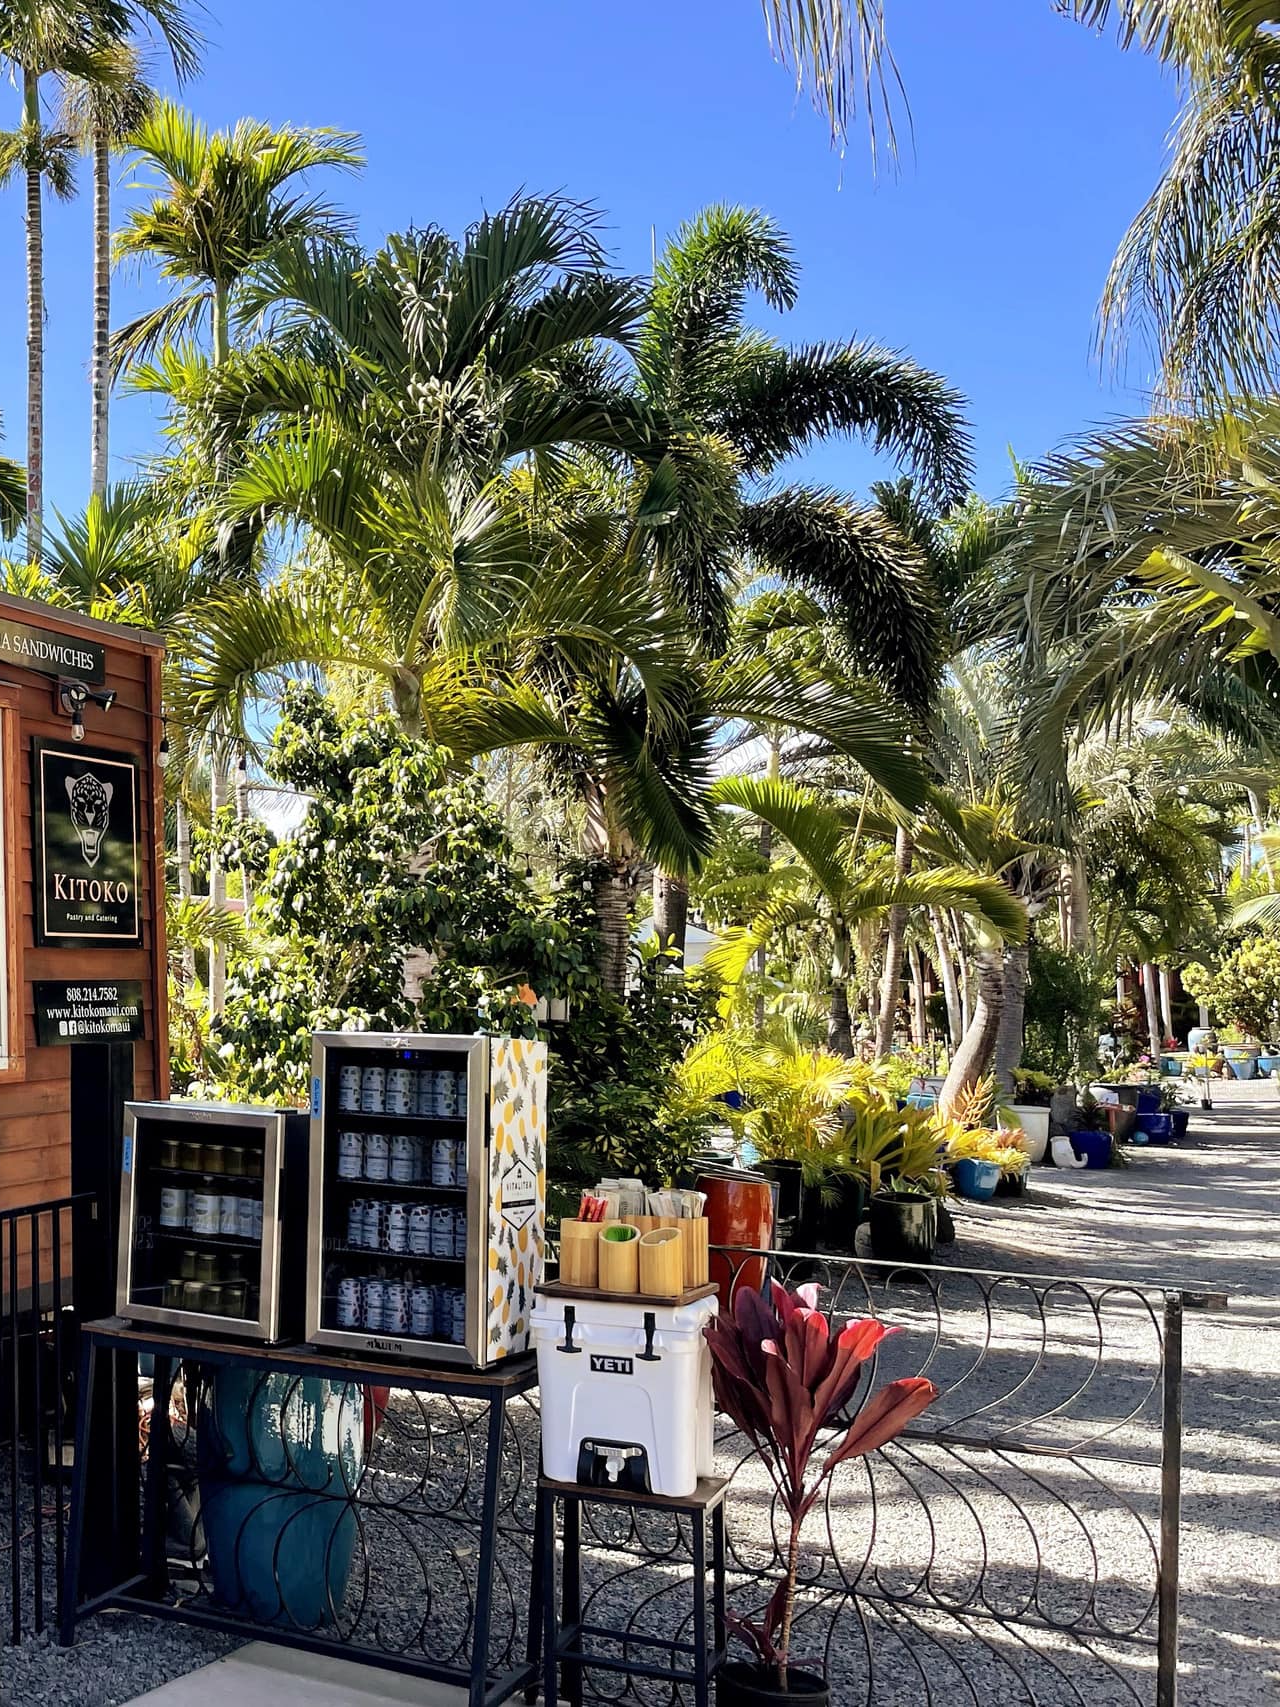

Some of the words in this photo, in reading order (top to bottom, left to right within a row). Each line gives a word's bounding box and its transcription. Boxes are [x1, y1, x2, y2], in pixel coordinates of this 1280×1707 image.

[13, 637, 94, 671] SANDWICHES
[54, 873, 129, 904] KITOKO
[66, 912, 84, 922] Pastry
[85, 913, 94, 922] and
[95, 914, 118, 924] Catering
[66, 986, 118, 1002] 808.214.7582
[46, 1002, 138, 1020] www.kitokomaui.com
[77, 1019, 131, 1036] @kitokomaui
[591, 1358, 630, 1373] YETI
